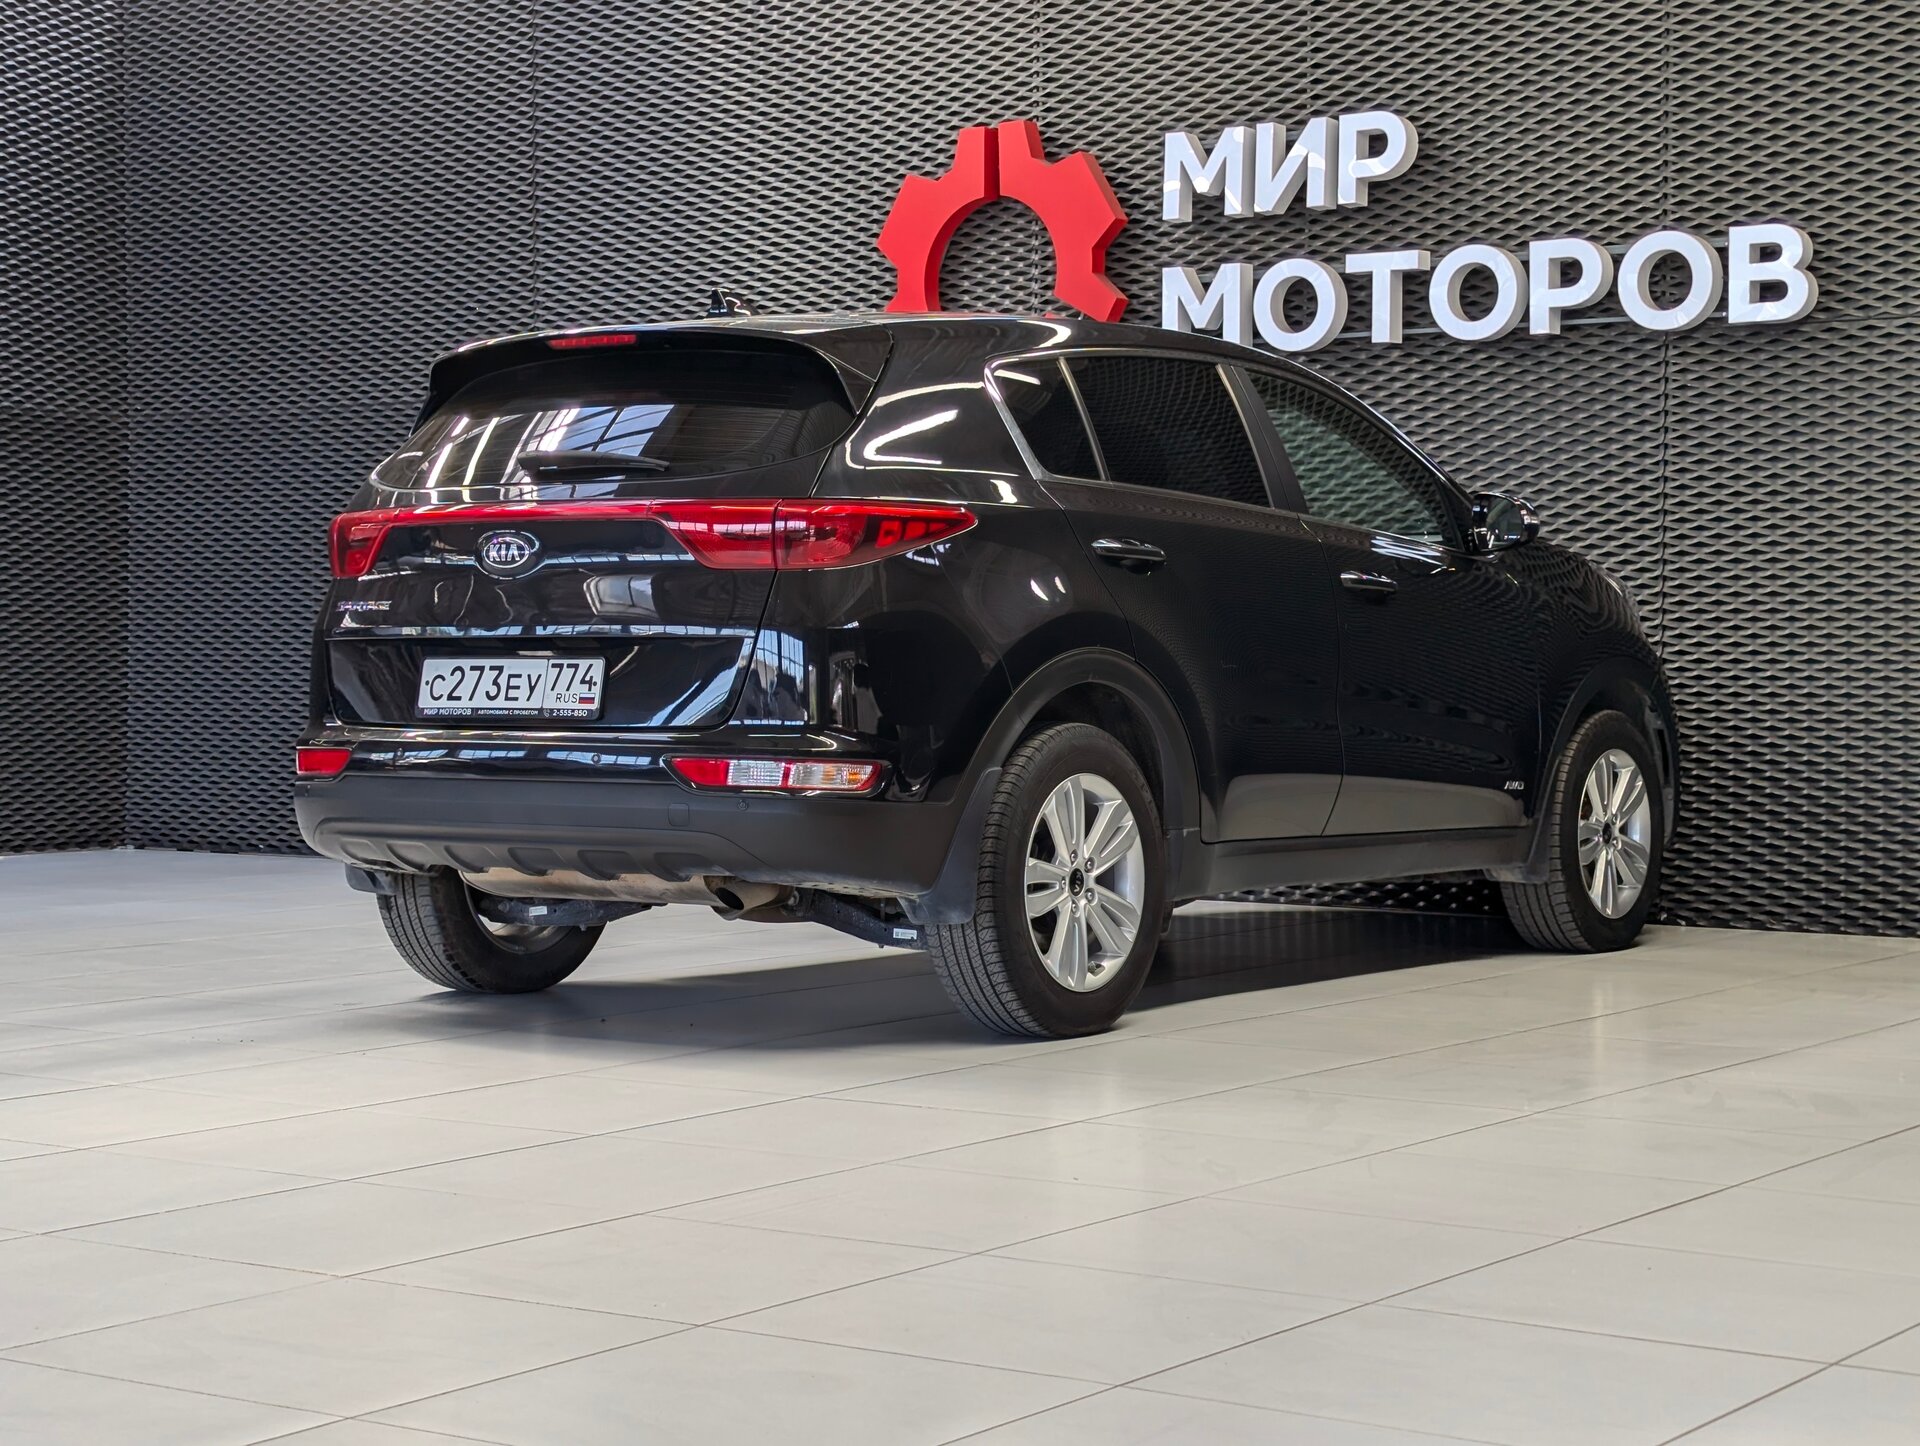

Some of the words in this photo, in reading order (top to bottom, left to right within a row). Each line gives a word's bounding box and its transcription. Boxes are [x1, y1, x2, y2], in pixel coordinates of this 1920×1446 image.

[1162, 110, 1419, 223] МИР
[1161, 223, 1819, 352] МОТОРОВ
[489, 545, 519, 562] KIA
[430, 665, 542, 702] С273ЕУ
[550, 663, 593, 692] 774
[423, 708, 438, 716] МИР
[439, 708, 472, 716] МОТОРОВ
[552, 709, 588, 717] 2-555-850
[555, 692, 578, 704] RUS
